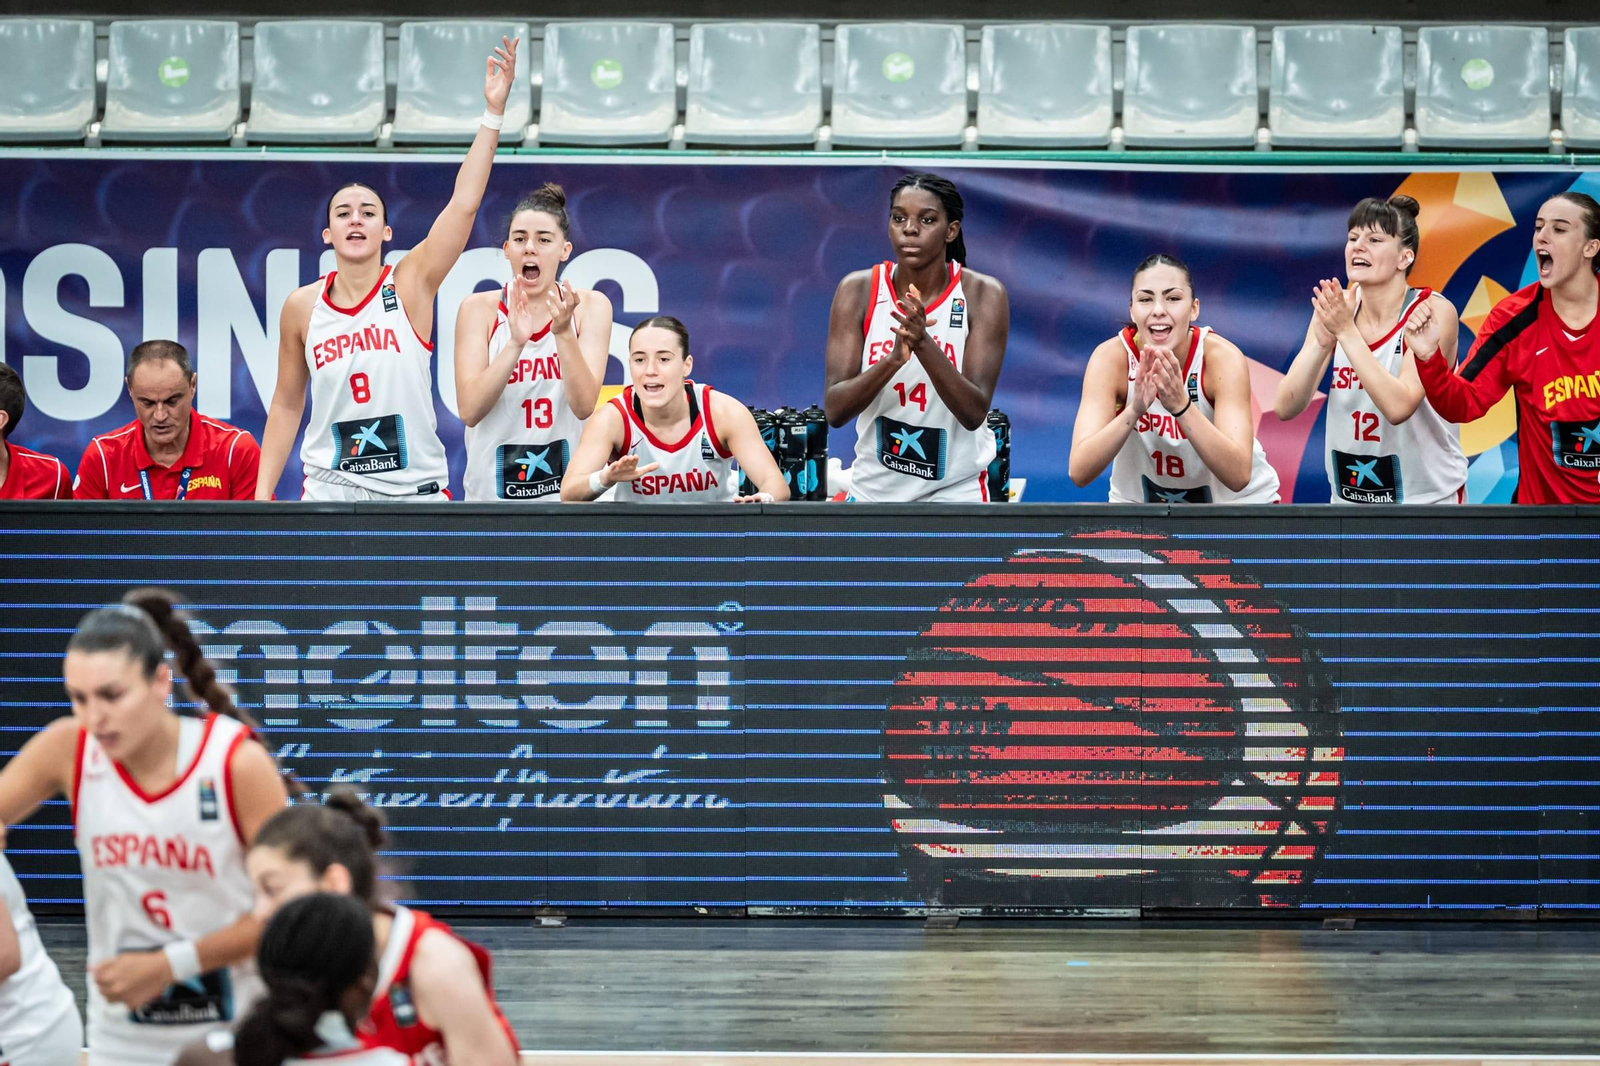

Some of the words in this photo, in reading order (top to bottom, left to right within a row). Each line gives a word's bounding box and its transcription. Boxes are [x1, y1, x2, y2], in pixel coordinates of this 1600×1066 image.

[313, 324, 401, 370] ESPAÑA
[507, 353, 562, 384] SPAÑ
[349, 372, 371, 404] 8
[893, 382, 927, 412] 14
[1543, 371, 1600, 409] ESPAÑ
[521, 398, 553, 429] 13
[1352, 410, 1380, 442] 12
[340, 457, 398, 472] CaixaBank
[882, 454, 934, 478] CaixaBank
[1151, 450, 1185, 478] 18
[1563, 454, 1600, 468] Caixa
[187, 475, 222, 491] ESPAÑA
[506, 480, 561, 497] CaixaBank
[631, 468, 719, 495] ESPAÑA
[1342, 487, 1393, 503] CaixaBank
[91, 833, 215, 880] ESPAÑA
[141, 890, 173, 930] 6
